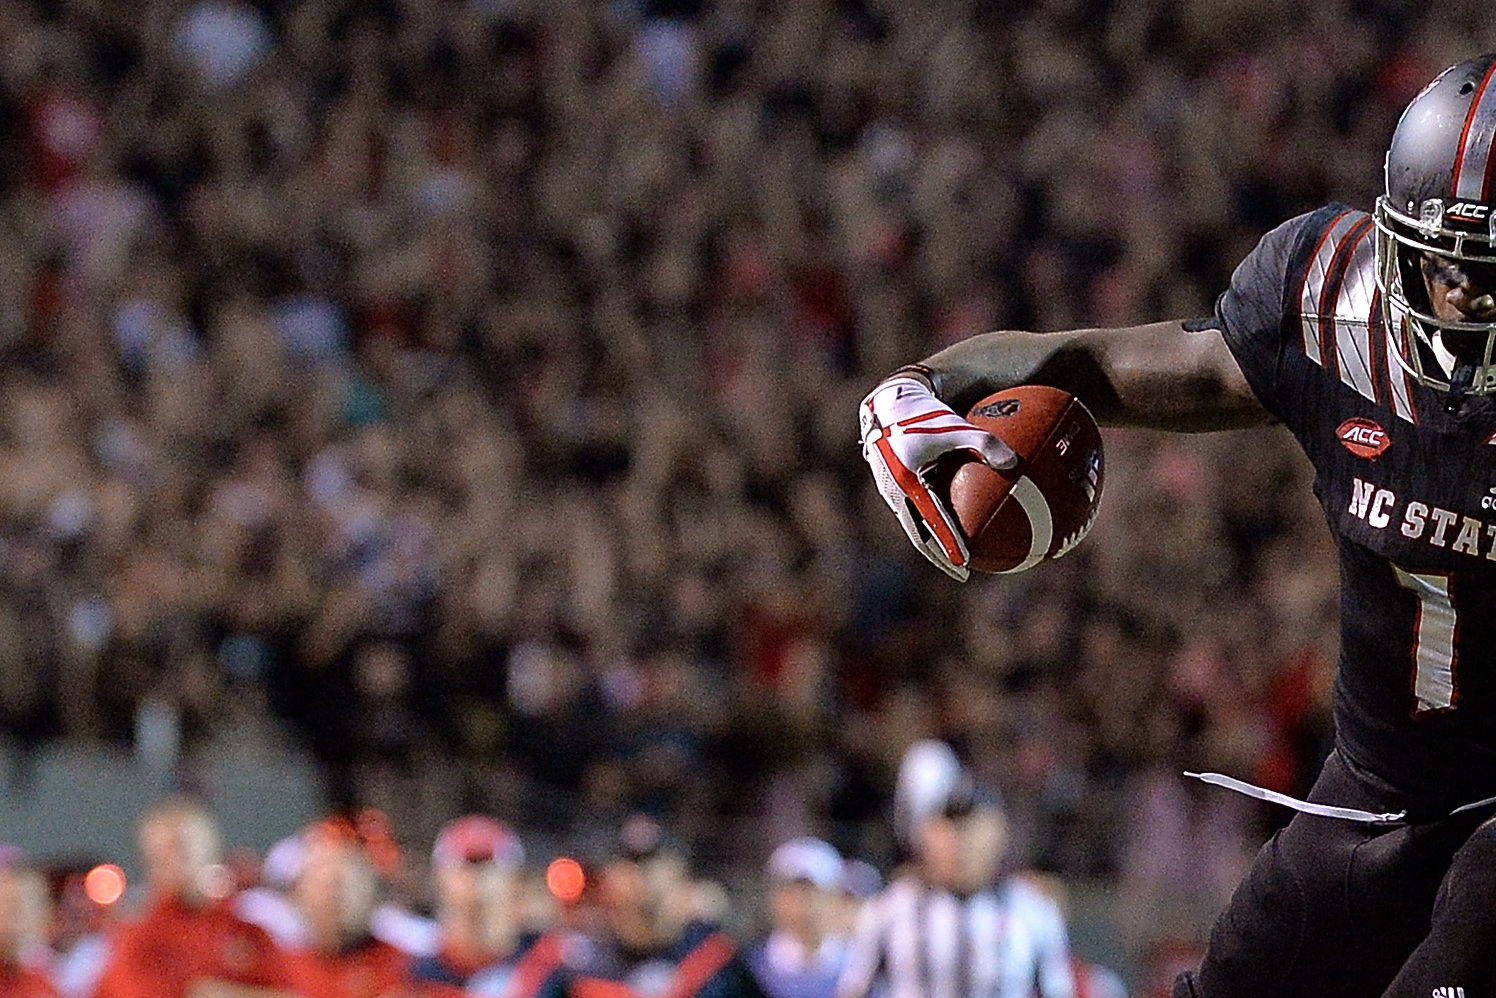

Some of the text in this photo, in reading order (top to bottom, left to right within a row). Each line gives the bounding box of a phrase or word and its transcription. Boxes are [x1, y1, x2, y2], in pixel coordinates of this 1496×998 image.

[1446, 202, 1489, 219] ACC
[1343, 426, 1385, 445] ACC
[1348, 477, 1396, 529] NC
[1388, 560, 1459, 721] 1
